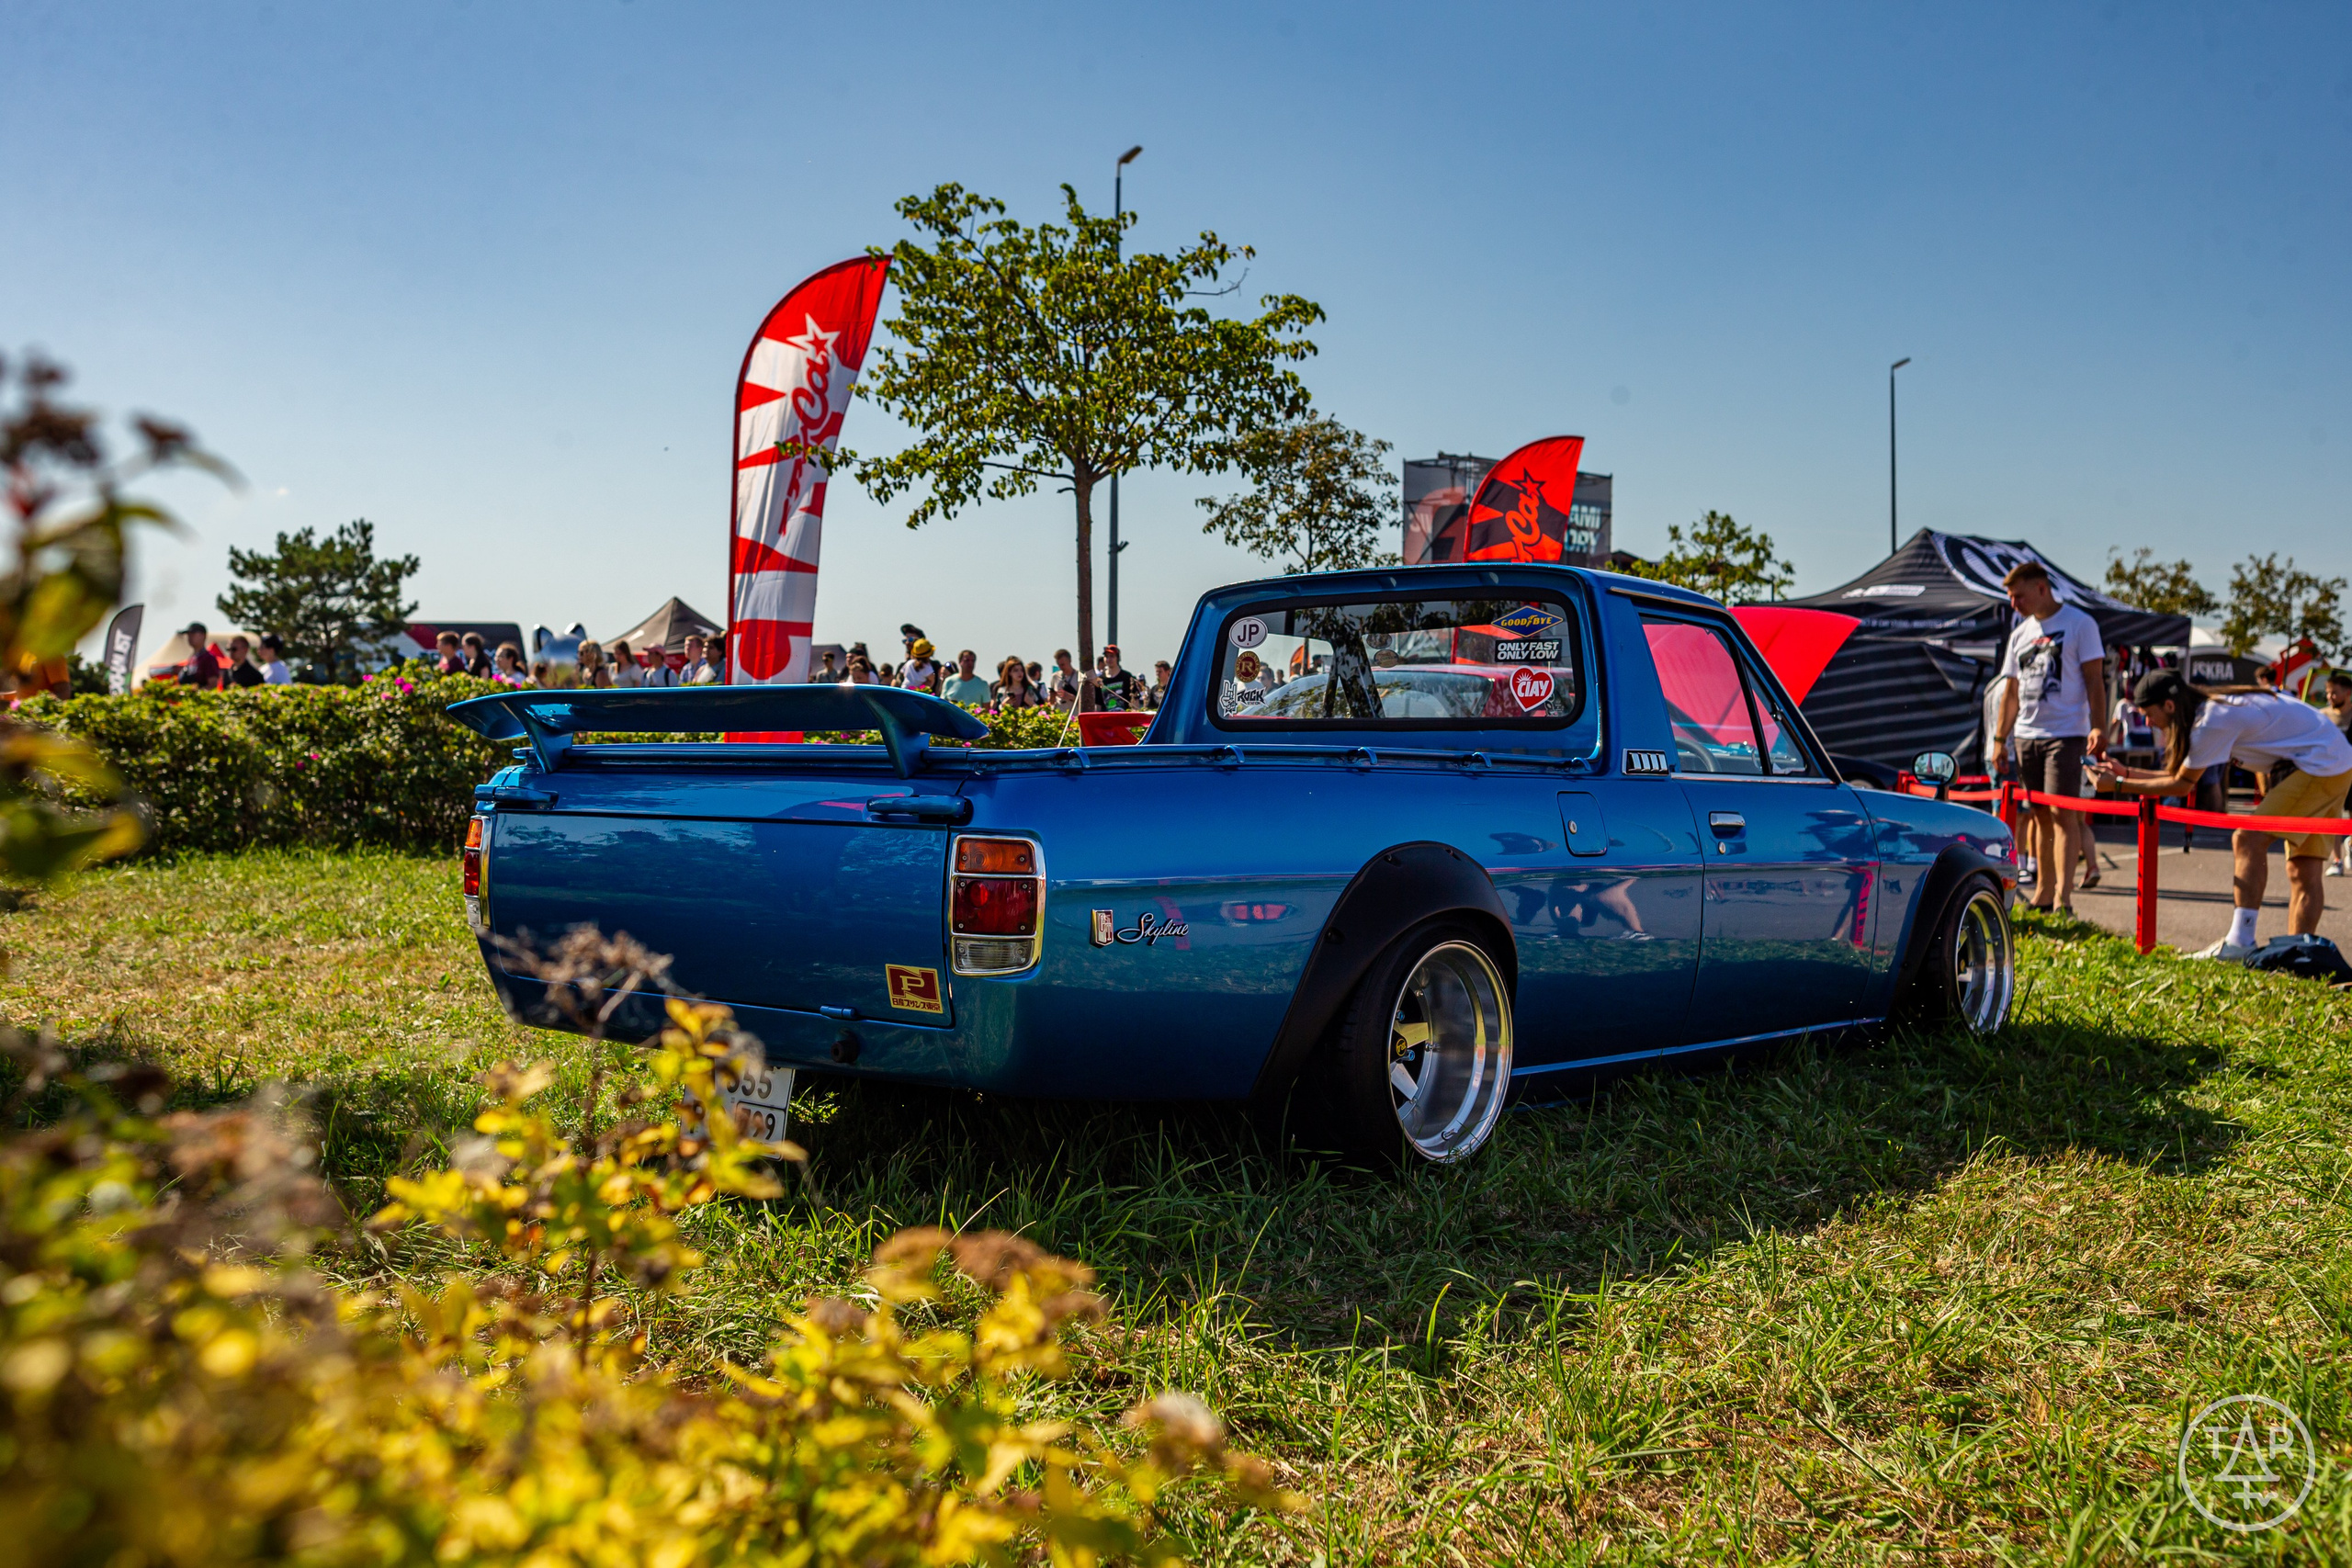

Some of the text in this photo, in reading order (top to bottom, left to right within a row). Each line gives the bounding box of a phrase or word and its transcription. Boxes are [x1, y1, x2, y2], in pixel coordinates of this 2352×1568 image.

[1238, 624, 1260, 643] JP
[1498, 641, 1559, 651] ONLY FAST
[1498, 650, 1559, 660] ONLY LOW
[1238, 690, 1266, 705] ROCK
[1117, 912, 1189, 945] Skyline
[899, 976, 925, 991] P
